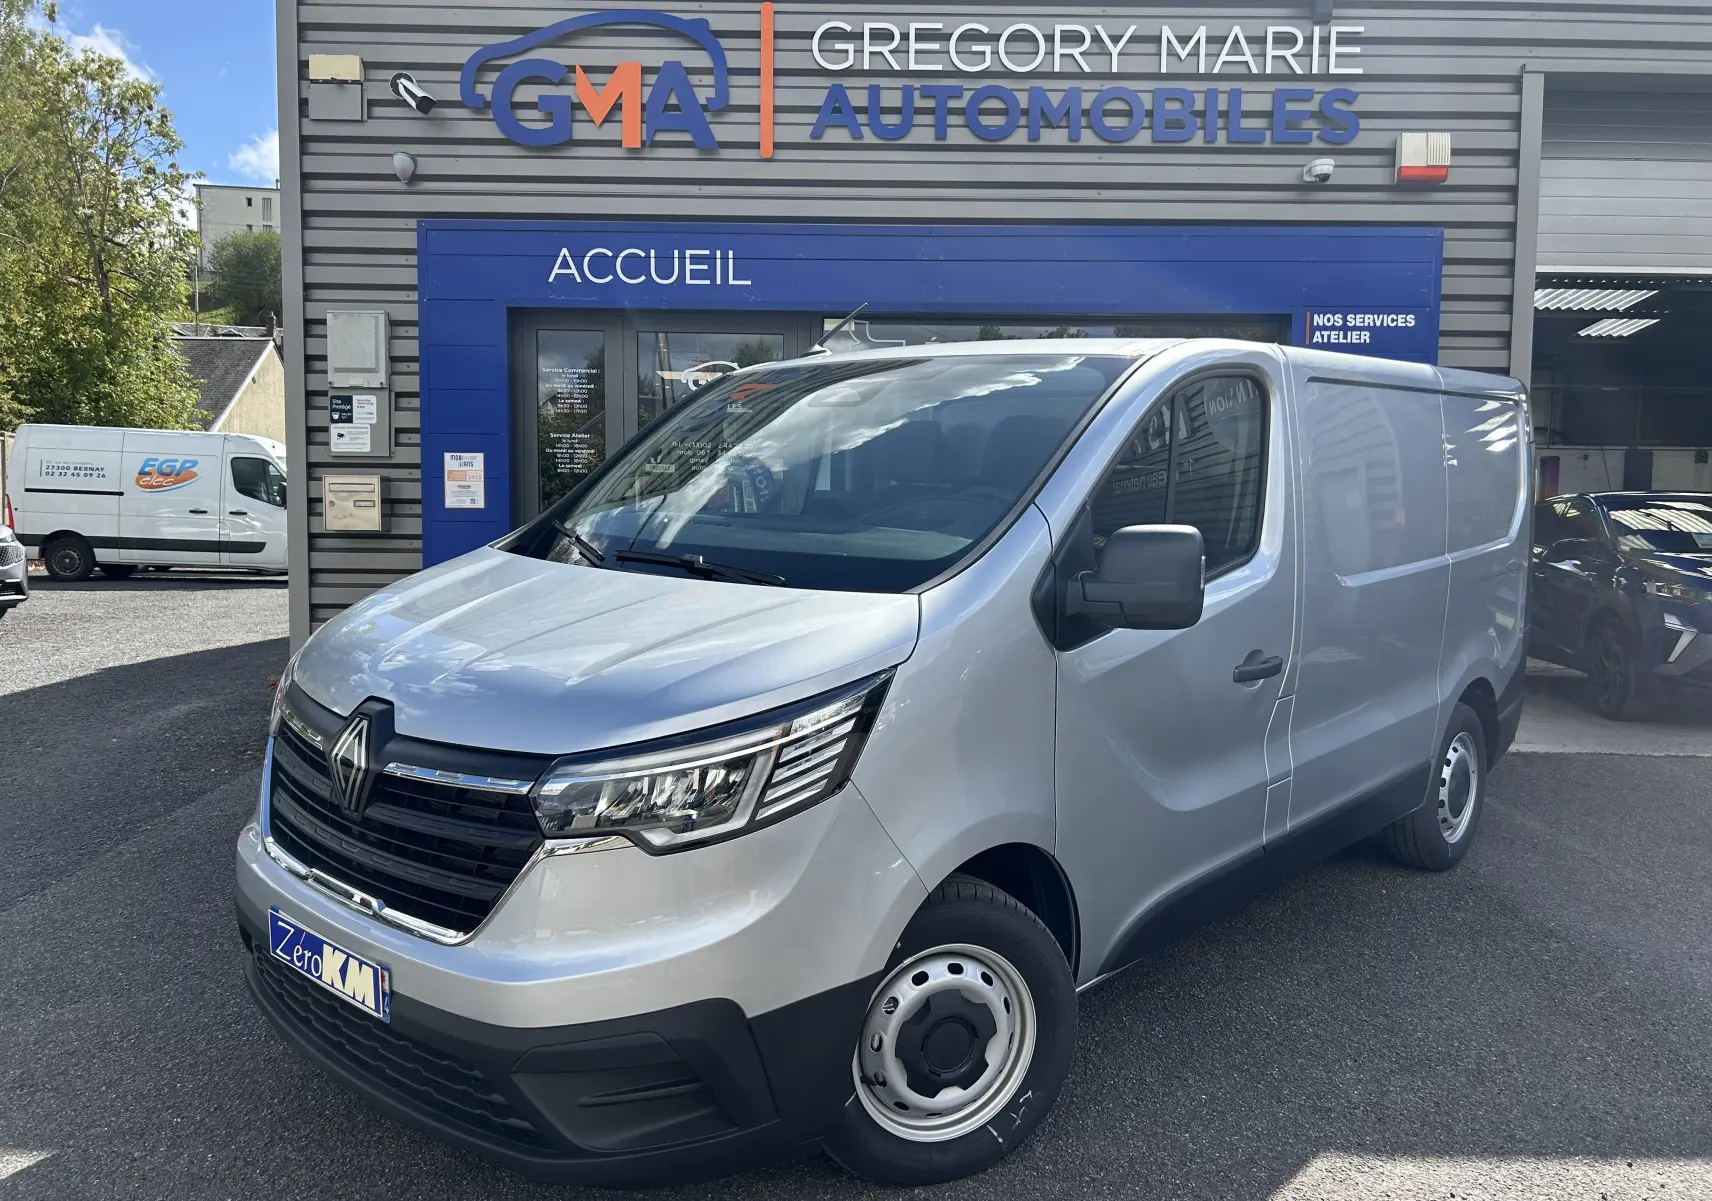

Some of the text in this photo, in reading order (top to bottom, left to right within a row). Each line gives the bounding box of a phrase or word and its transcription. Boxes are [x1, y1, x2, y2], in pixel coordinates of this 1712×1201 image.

[811, 21, 1364, 75] GREGORY MARIE
[491, 59, 717, 149] GMA
[810, 83, 1361, 145] AUTOMOBILES
[548, 247, 752, 286] ACCUEIL
[1313, 314, 1416, 327] NOS SERVICES
[1312, 331, 1371, 343] ATELIER
[138, 458, 198, 476] EGP
[140, 474, 175, 486] elec
